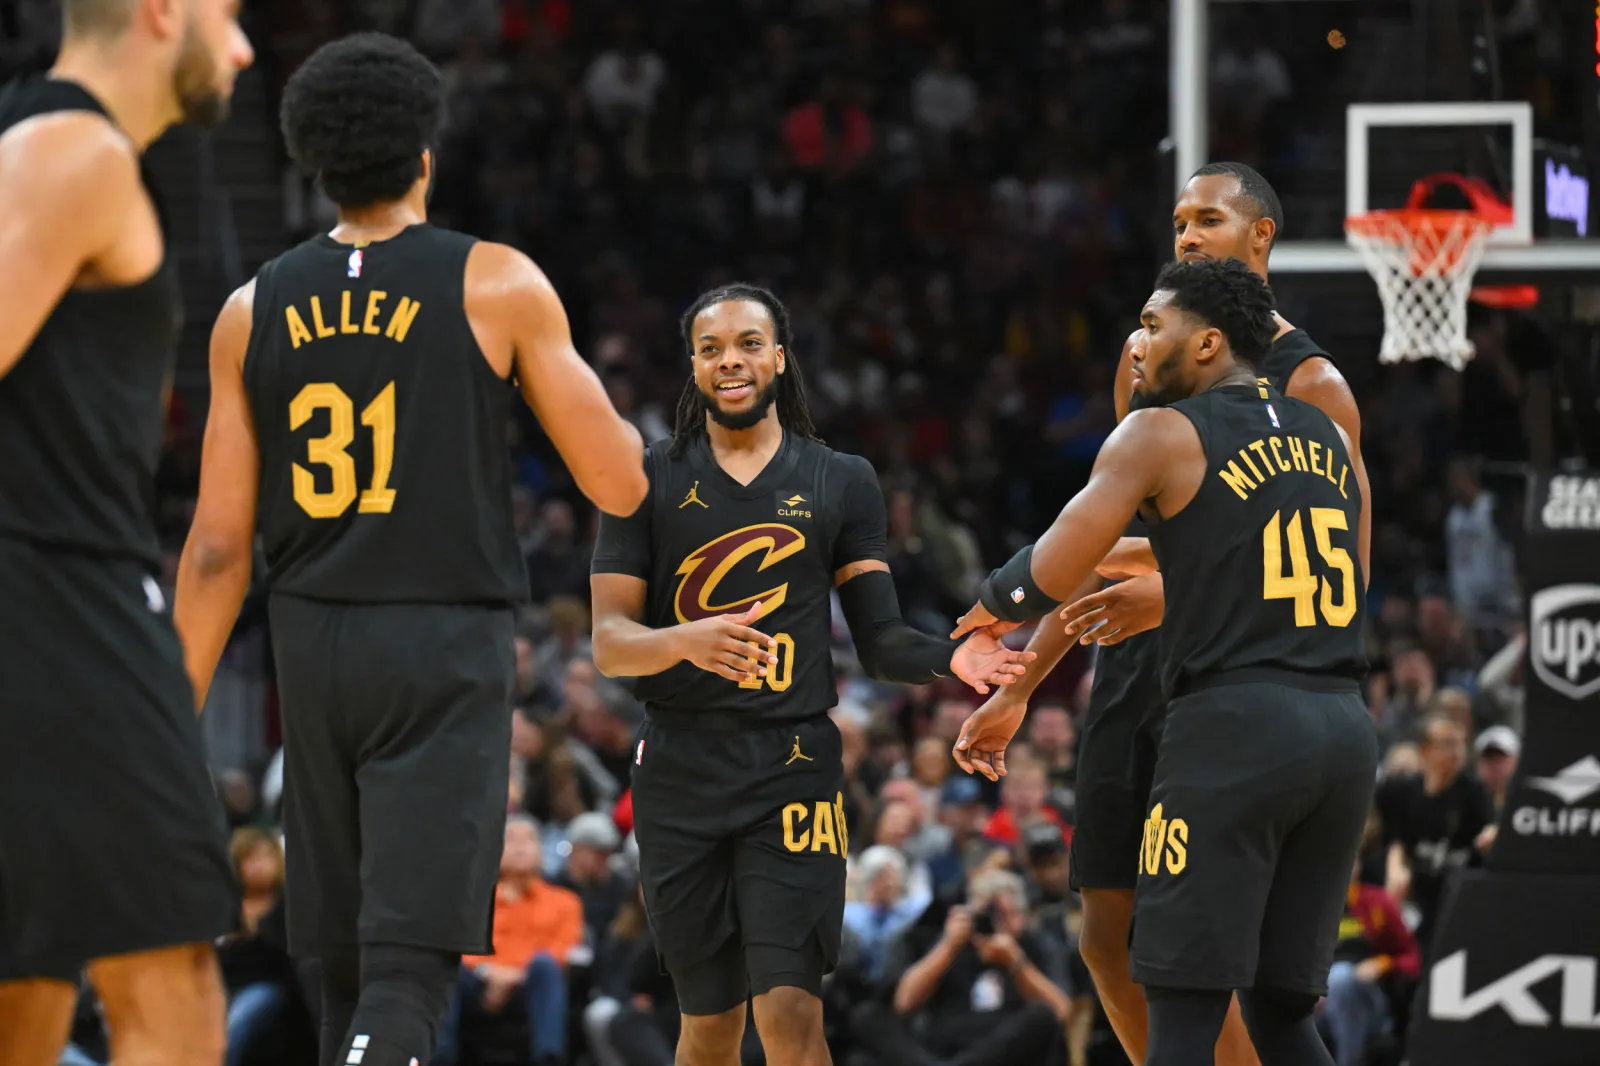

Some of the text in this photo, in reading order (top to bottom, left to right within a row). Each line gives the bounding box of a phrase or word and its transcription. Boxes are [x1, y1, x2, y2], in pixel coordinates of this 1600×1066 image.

[285, 289, 421, 349] ALLEN
[289, 380, 397, 519] 31
[1218, 436, 1348, 500] MITCHELL
[777, 508, 812, 518] CLIFFS
[1549, 475, 1600, 500] SEA
[1263, 507, 1357, 627] 45
[738, 632, 795, 692] 10
[1541, 617, 1600, 681] up
[1138, 802, 1189, 875] VS
[1428, 949, 1600, 1029] KI
